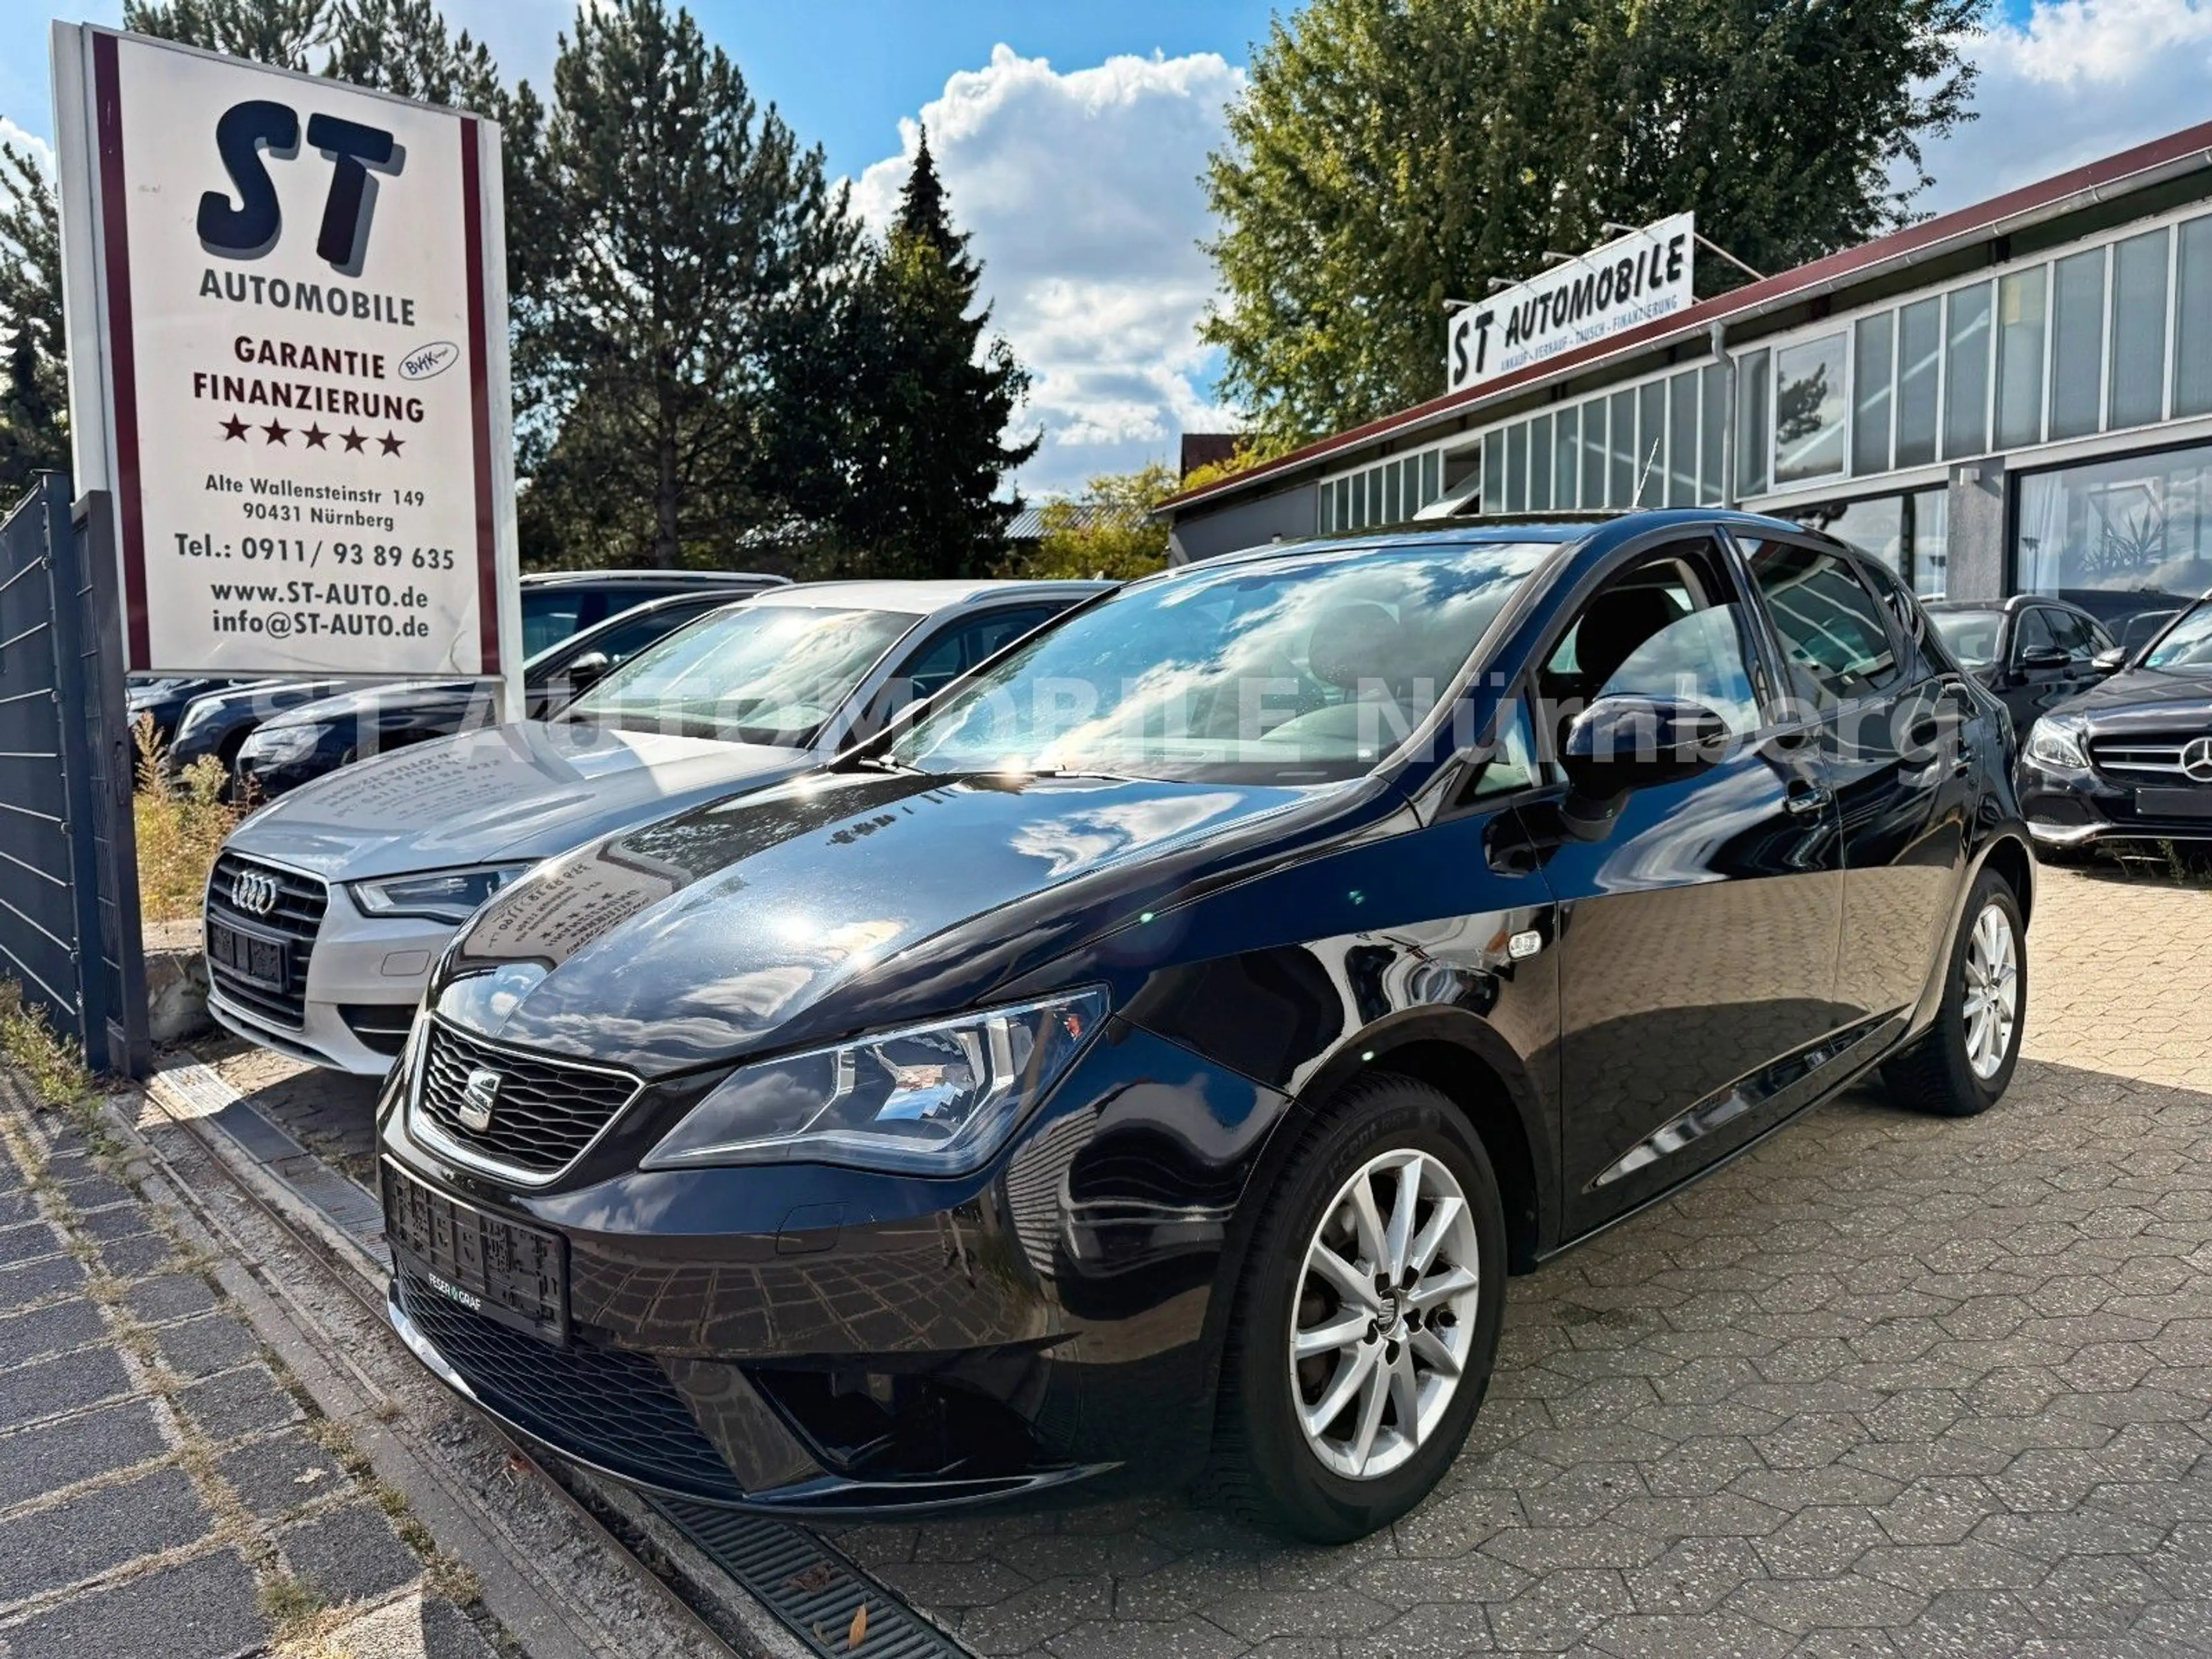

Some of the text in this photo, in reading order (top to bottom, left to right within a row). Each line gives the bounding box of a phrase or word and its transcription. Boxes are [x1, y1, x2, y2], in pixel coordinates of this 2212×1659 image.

[196, 99, 407, 278] ST
[199, 268, 415, 327] AUTOMOBILE
[1453, 233, 1685, 385] ST AUTOMOBILE
[234, 335, 385, 380] GARANTIE
[194, 372, 424, 423] FINANZIERUNG
[205, 474, 424, 506] Alte Wallensteinstr 149
[243, 502, 393, 532] 90431 Nürnberg
[175, 533, 231, 558] Tel.:
[333, 542, 363, 565] 93
[374, 545, 402, 567] 89
[412, 547, 454, 570] 635
[210, 581, 427, 608] www.ST-AUTO.de
[213, 609, 429, 639] info@ST-AUTO.de
